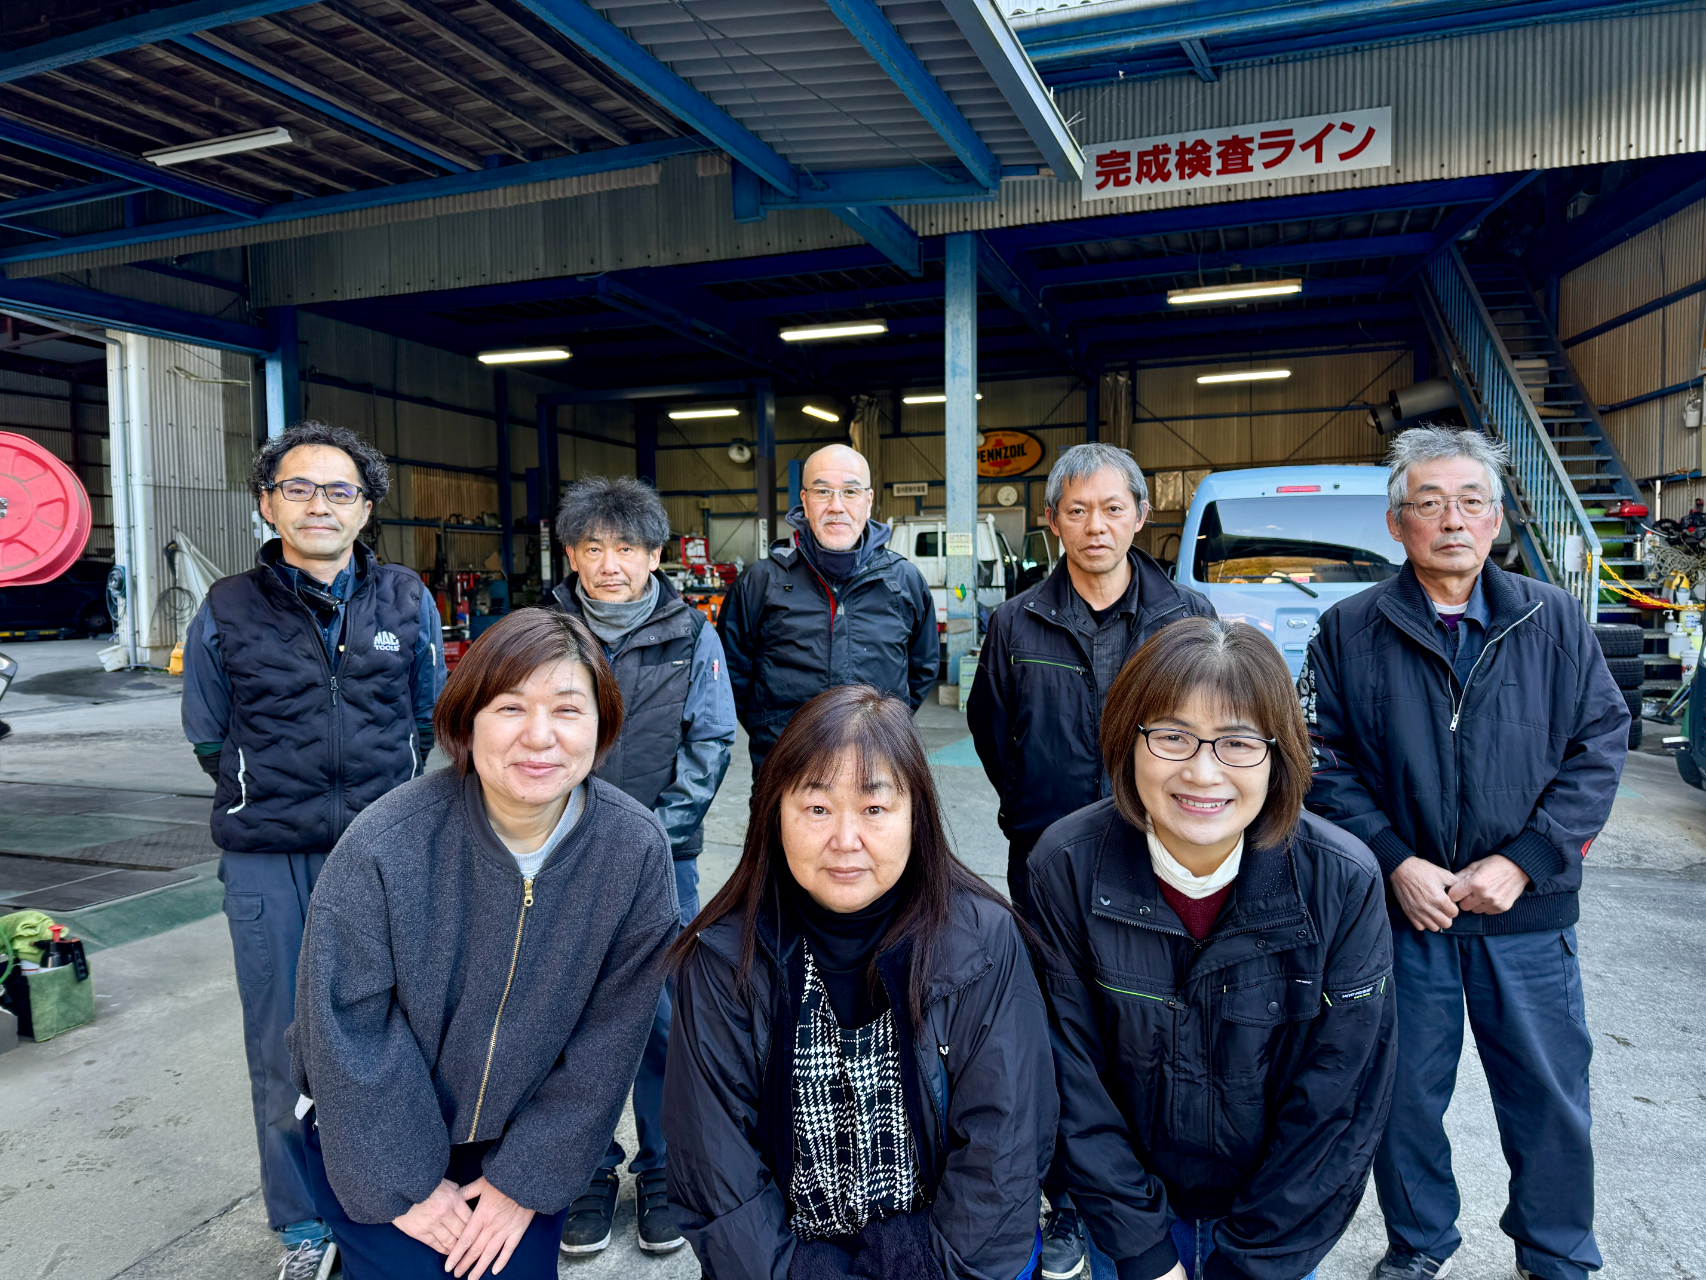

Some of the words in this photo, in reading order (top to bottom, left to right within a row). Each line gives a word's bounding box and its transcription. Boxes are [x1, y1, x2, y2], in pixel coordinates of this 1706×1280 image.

[1095, 121, 1376, 191] 完成検査ライン
[374, 631, 400, 645] MAC
[1308, 691, 1318, 724] BLACK
